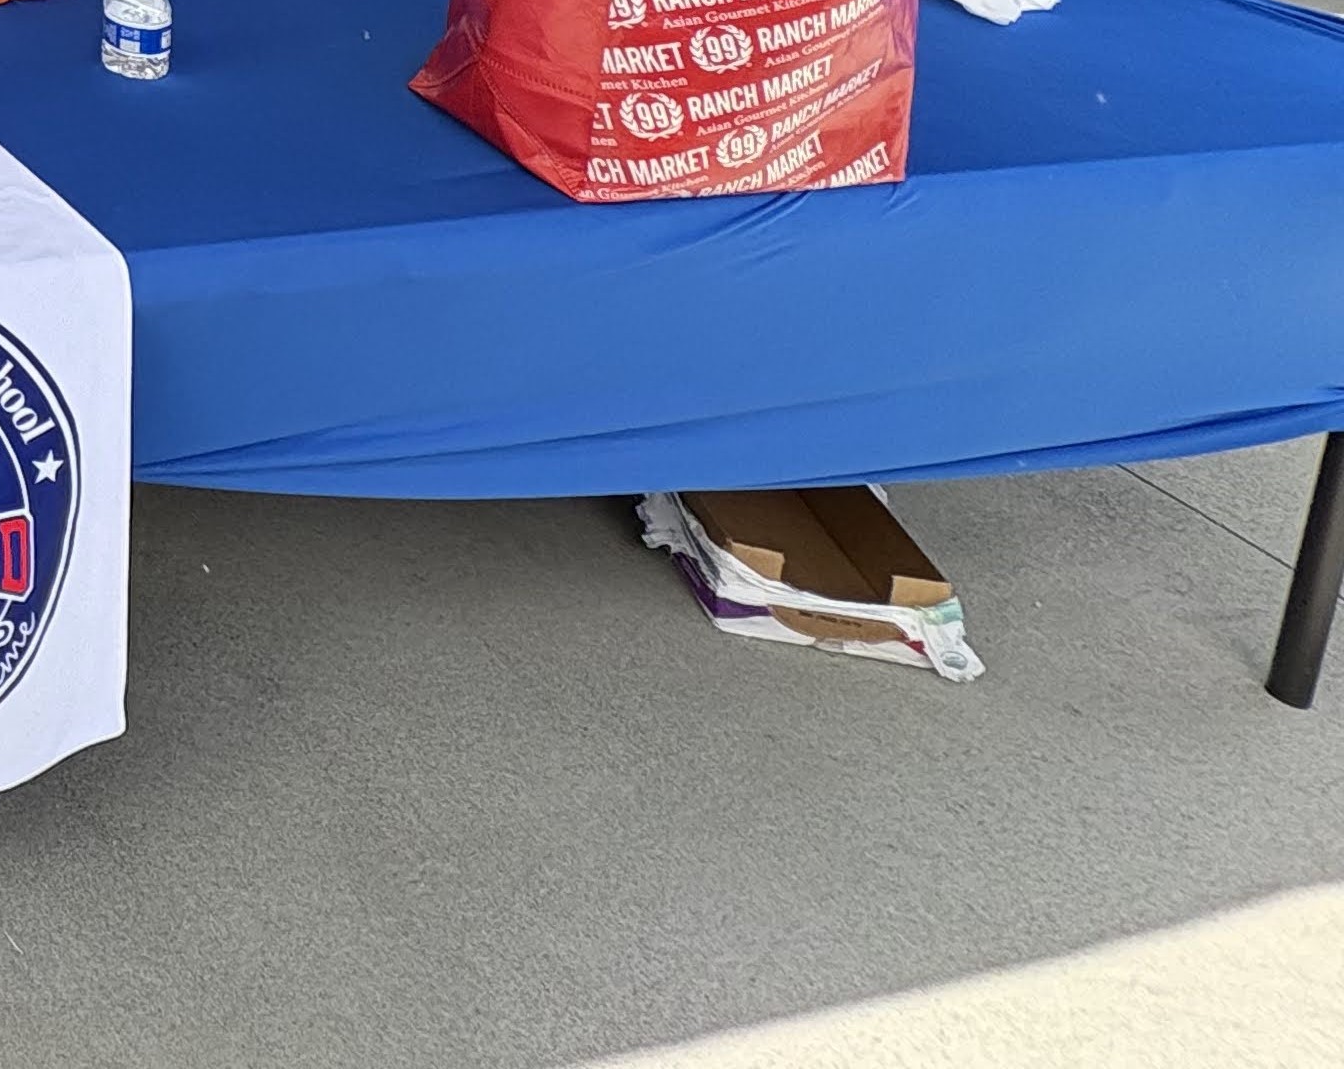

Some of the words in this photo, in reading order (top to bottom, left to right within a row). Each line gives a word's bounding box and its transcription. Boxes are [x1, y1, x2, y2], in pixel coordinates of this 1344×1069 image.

[663, 15, 703, 30] Asian
[706, 5, 769, 24] Gourmet
[705, 35, 737, 61] 99
[756, 12, 826, 53] RANCH
[764, 50, 800, 68] Asian
[632, 76, 688, 90] Kitchen
[637, 102, 668, 128] 99
[687, 87, 758, 122] RANCH
[762, 54, 833, 103] MARKET
[696, 119, 732, 137] Asian
[734, 103, 788, 128] Gourmet
[731, 133, 755, 159] 99
[771, 98, 823, 142] RANCH
[627, 146, 712, 186] MARKET
[766, 130, 824, 185] MARKET
